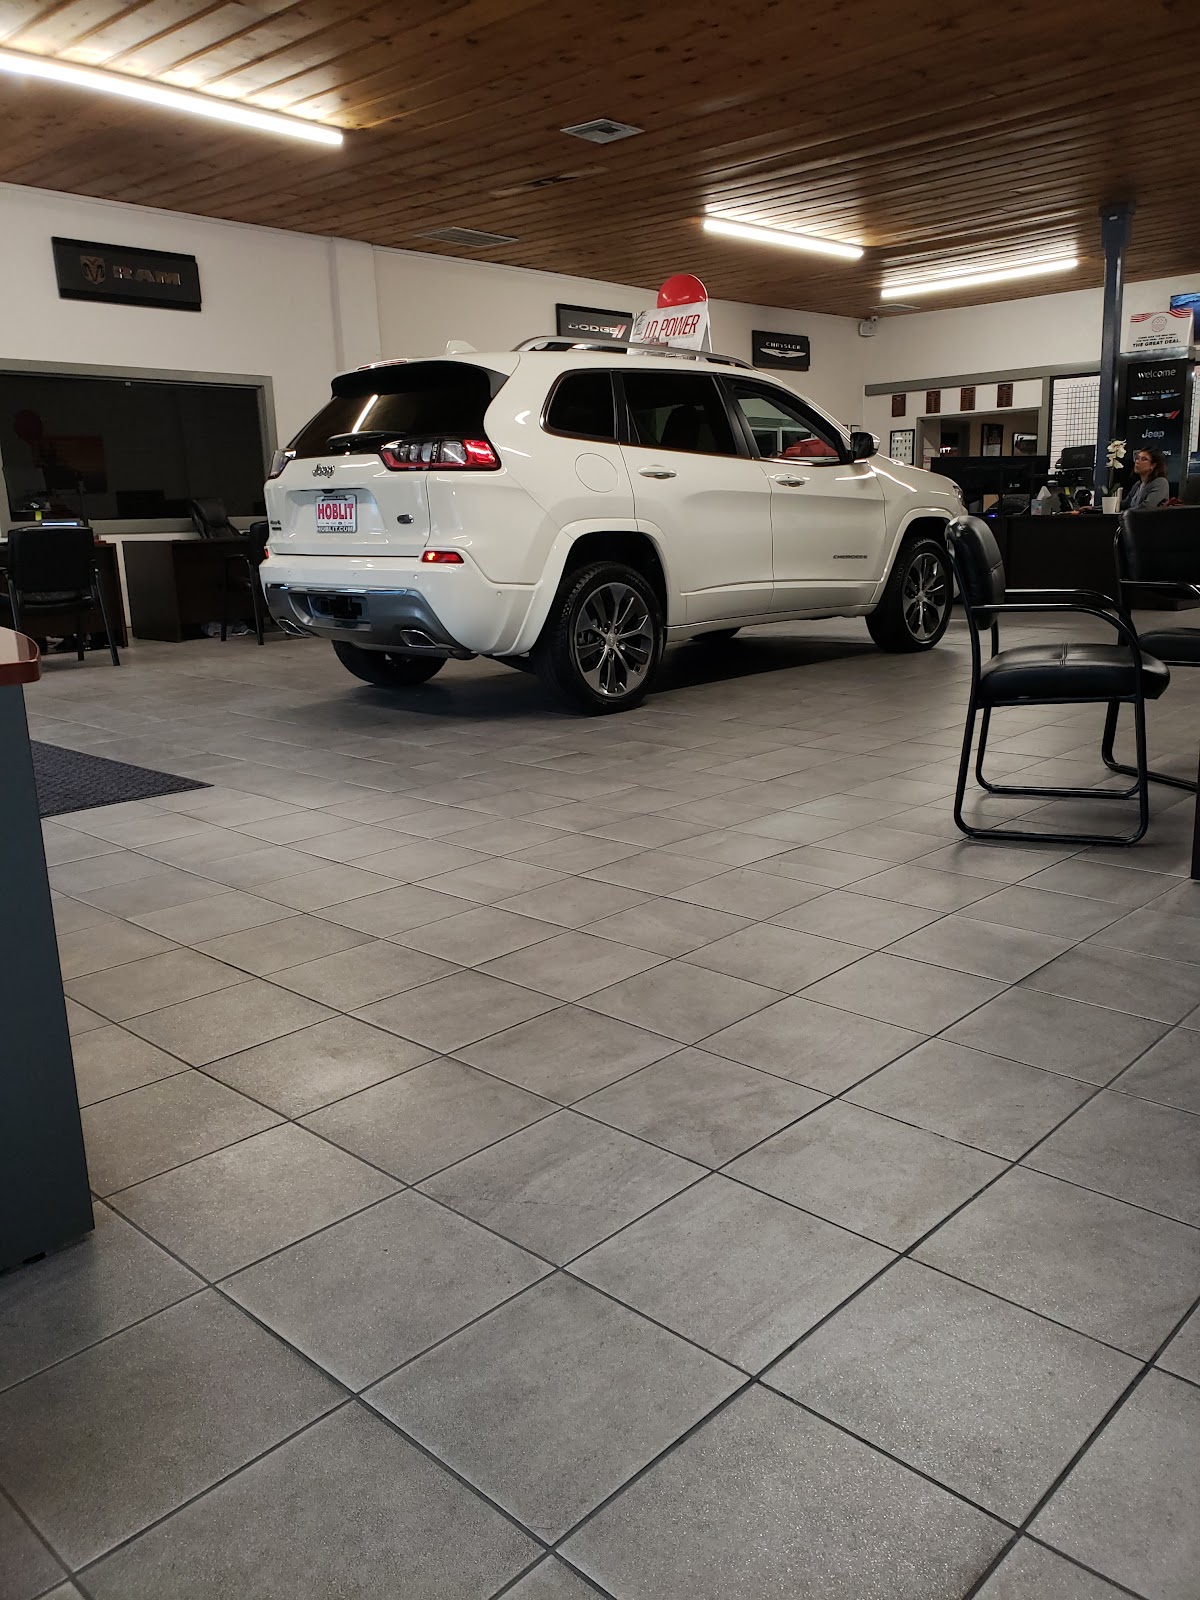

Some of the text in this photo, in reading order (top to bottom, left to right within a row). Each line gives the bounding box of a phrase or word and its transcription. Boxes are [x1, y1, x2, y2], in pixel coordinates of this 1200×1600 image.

[112, 265, 181, 286] RAM
[568, 322, 619, 335] DODGE
[640, 313, 701, 342] J.D. POWER
[765, 341, 801, 350] CHRYSLER
[1137, 368, 1177, 379] welcome
[1141, 429, 1165, 439] Jeep
[317, 503, 354, 520] HOBLIT
